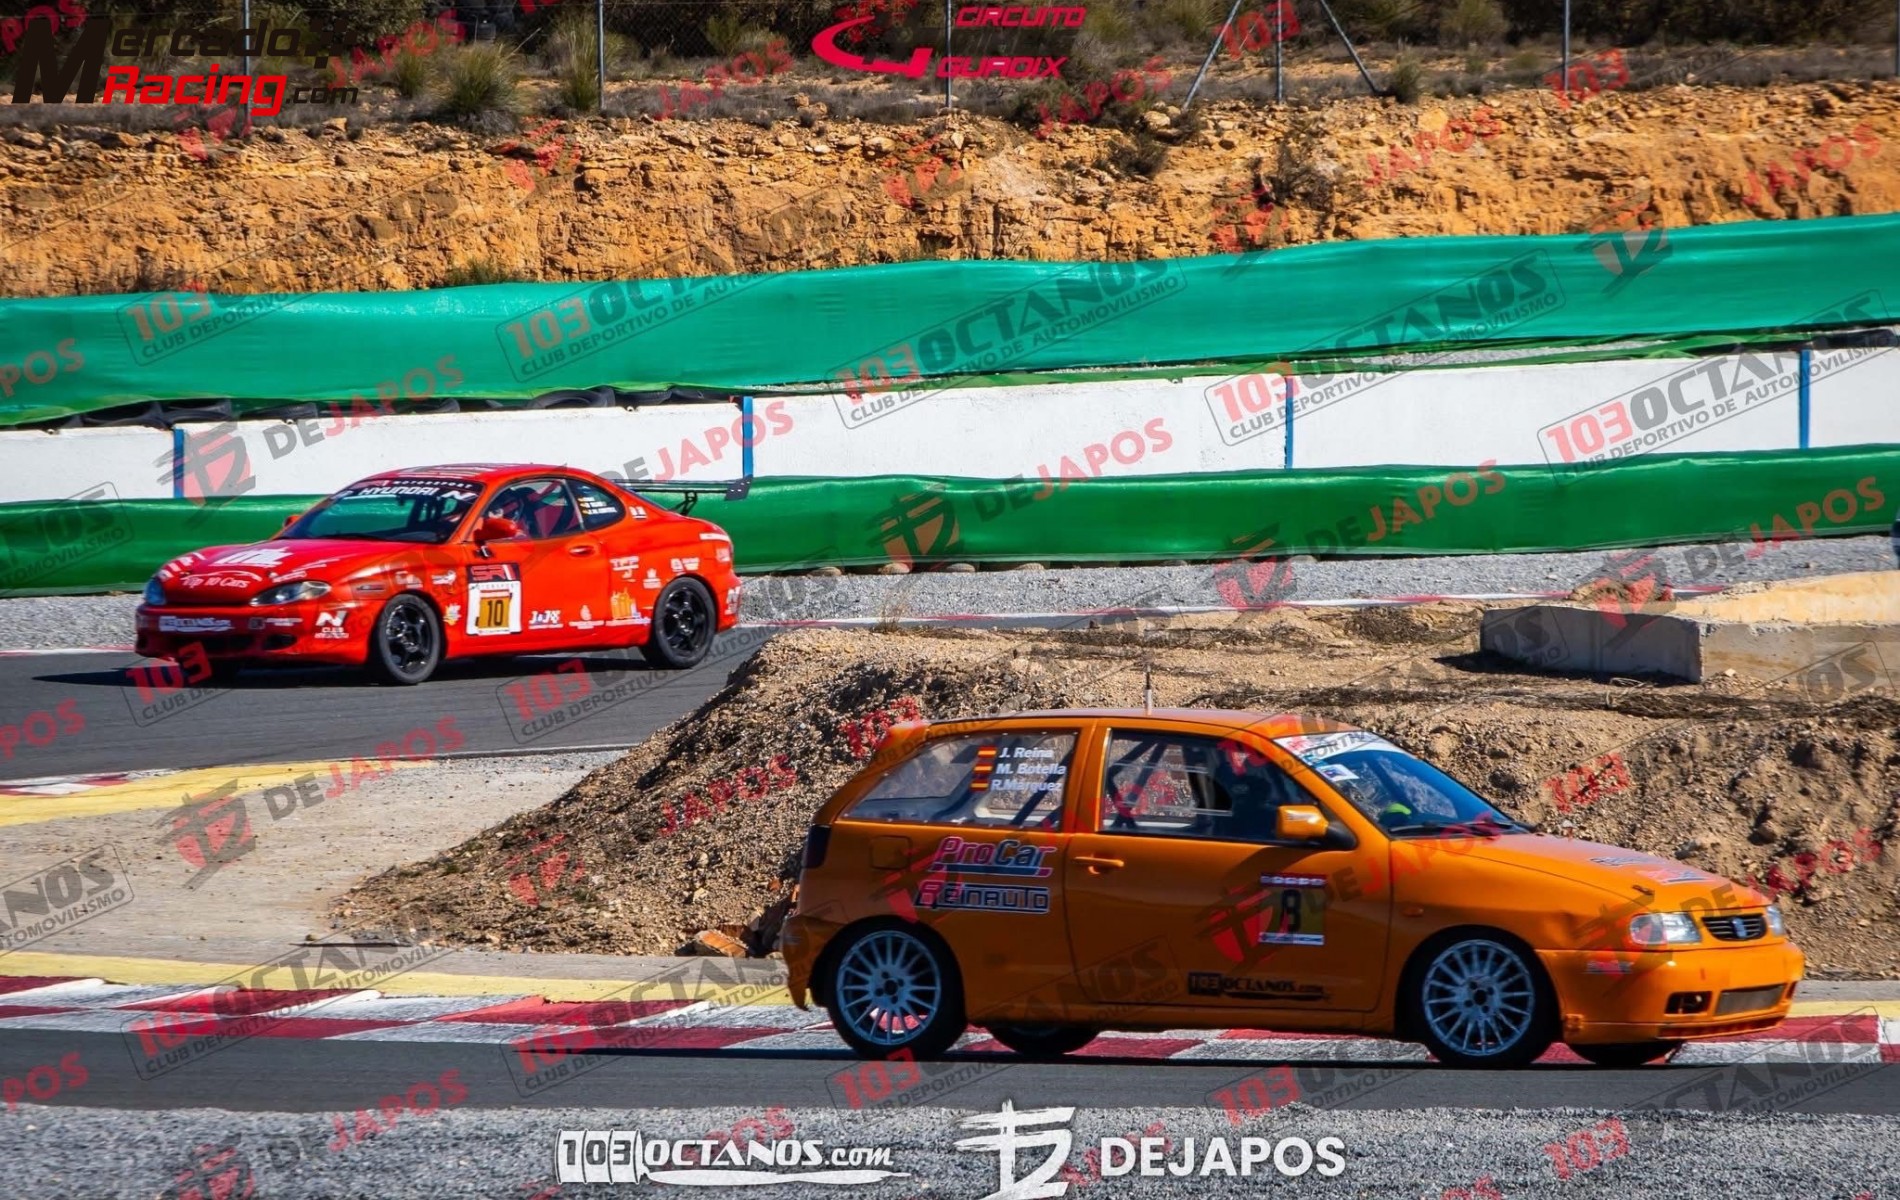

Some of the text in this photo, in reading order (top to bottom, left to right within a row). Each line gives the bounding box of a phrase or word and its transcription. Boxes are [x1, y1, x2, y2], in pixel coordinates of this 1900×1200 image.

[357, 486, 440, 496] HYUNDAI
[487, 599, 504, 627] 10
[998, 747, 1054, 758] J. Reina
[995, 762, 1067, 775] M. Botella
[933, 836, 1057, 867] ProCar
